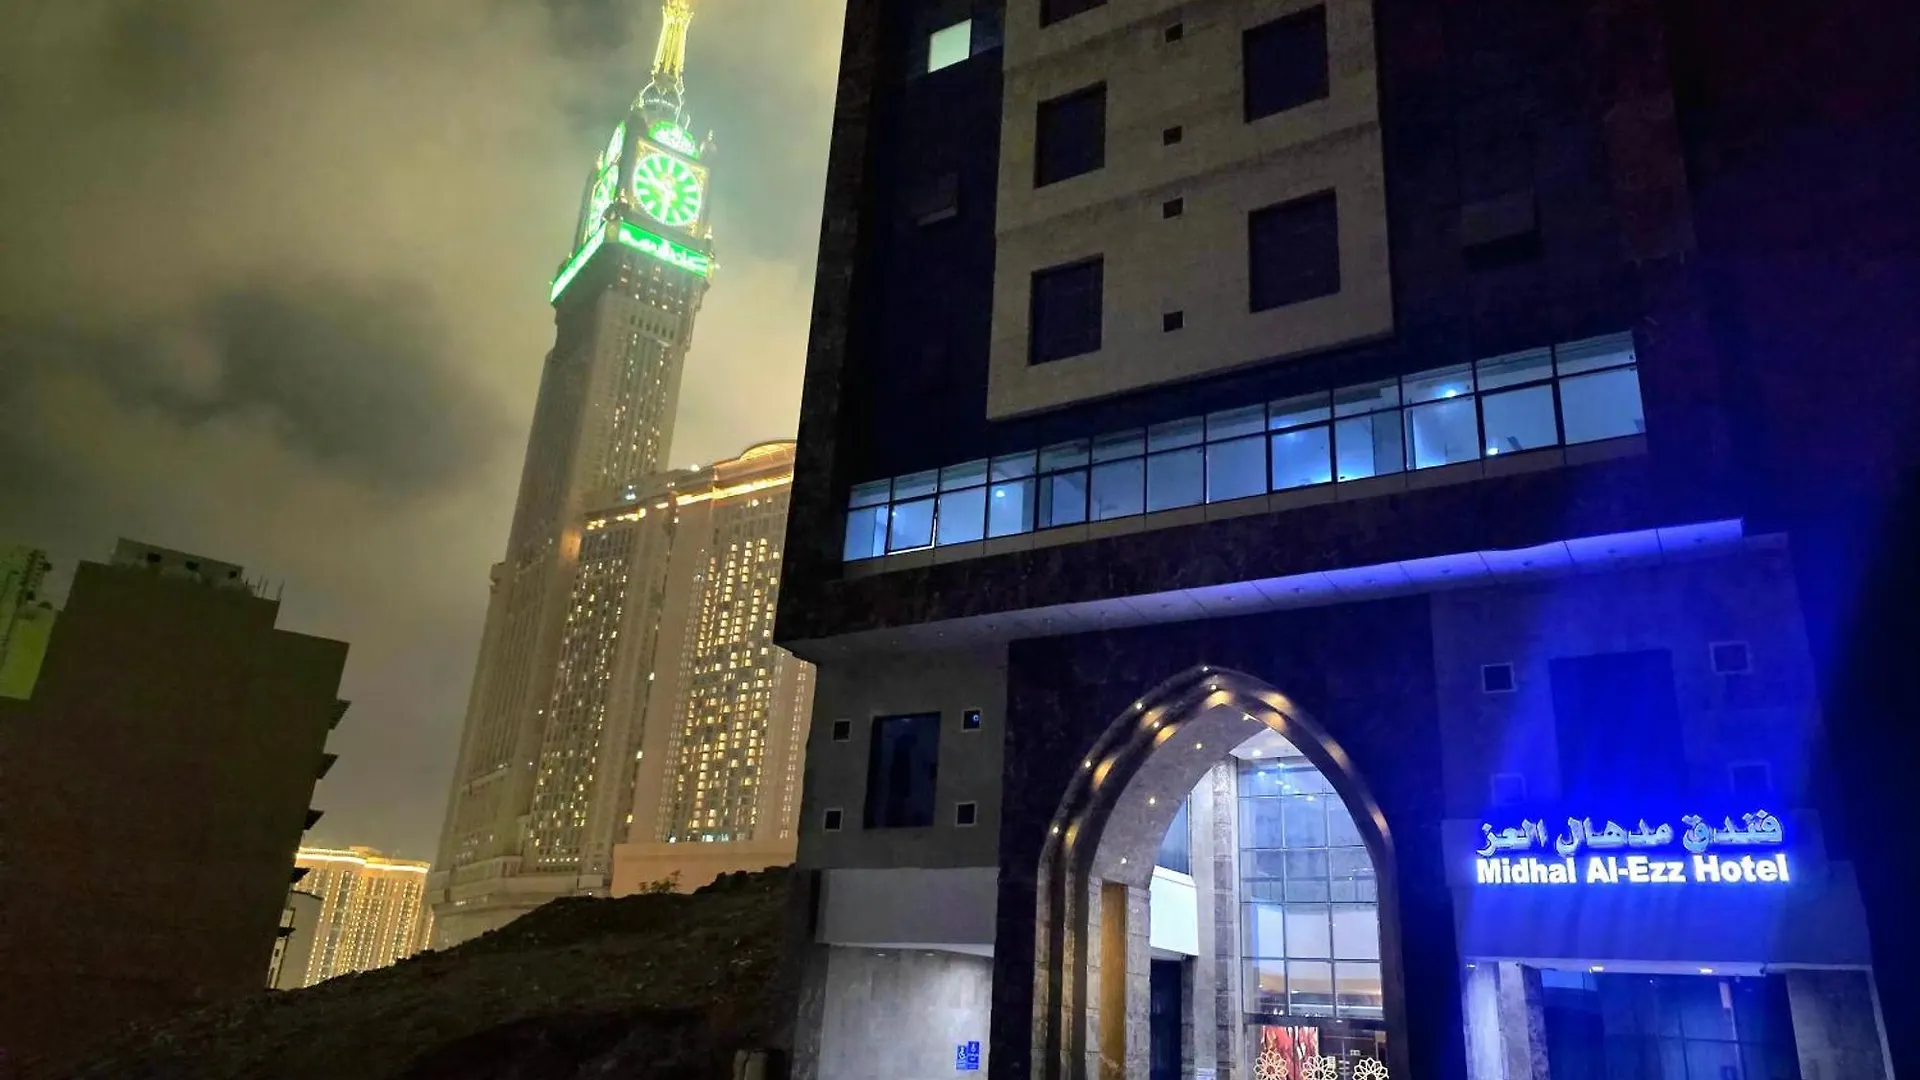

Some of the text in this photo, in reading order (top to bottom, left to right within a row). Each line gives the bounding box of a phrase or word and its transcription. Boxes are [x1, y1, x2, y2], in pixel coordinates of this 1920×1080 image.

[1476, 809, 1783, 857] فندق مدهال العز
[1476, 853, 1790, 884] Midhal Al-Ezz Hotel
